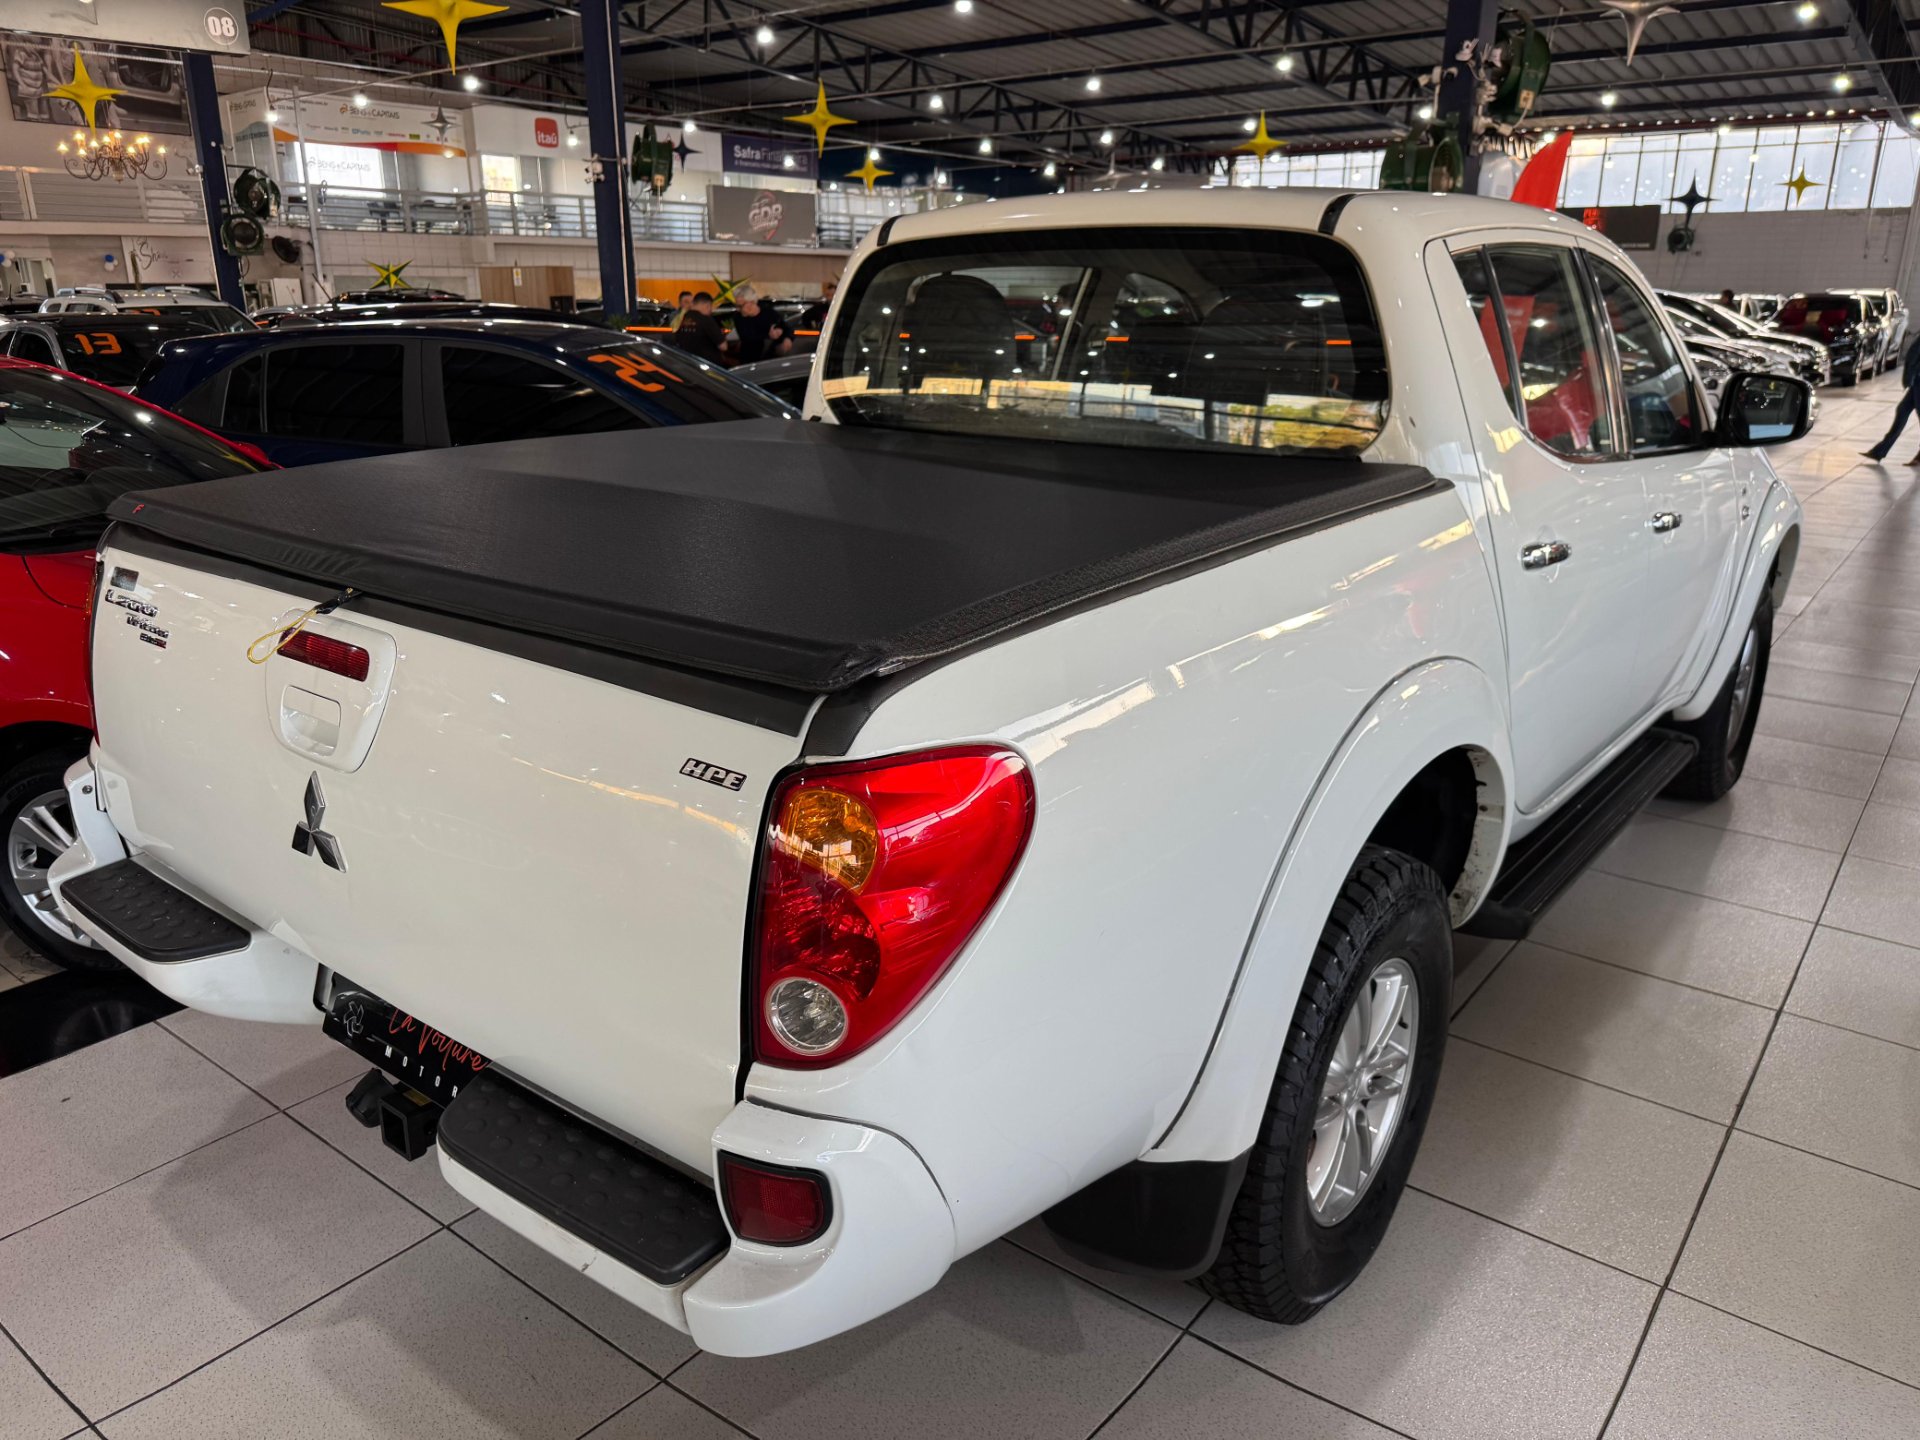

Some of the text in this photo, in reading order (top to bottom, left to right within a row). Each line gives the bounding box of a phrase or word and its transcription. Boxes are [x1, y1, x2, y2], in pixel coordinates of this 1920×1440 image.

[207, 16, 235, 37] 08
[537, 130, 557, 145] itaú
[75, 333, 122, 355] 13
[587, 353, 684, 392] 24
[105, 589, 159, 618] L200
[680, 758, 747, 792] HPE
